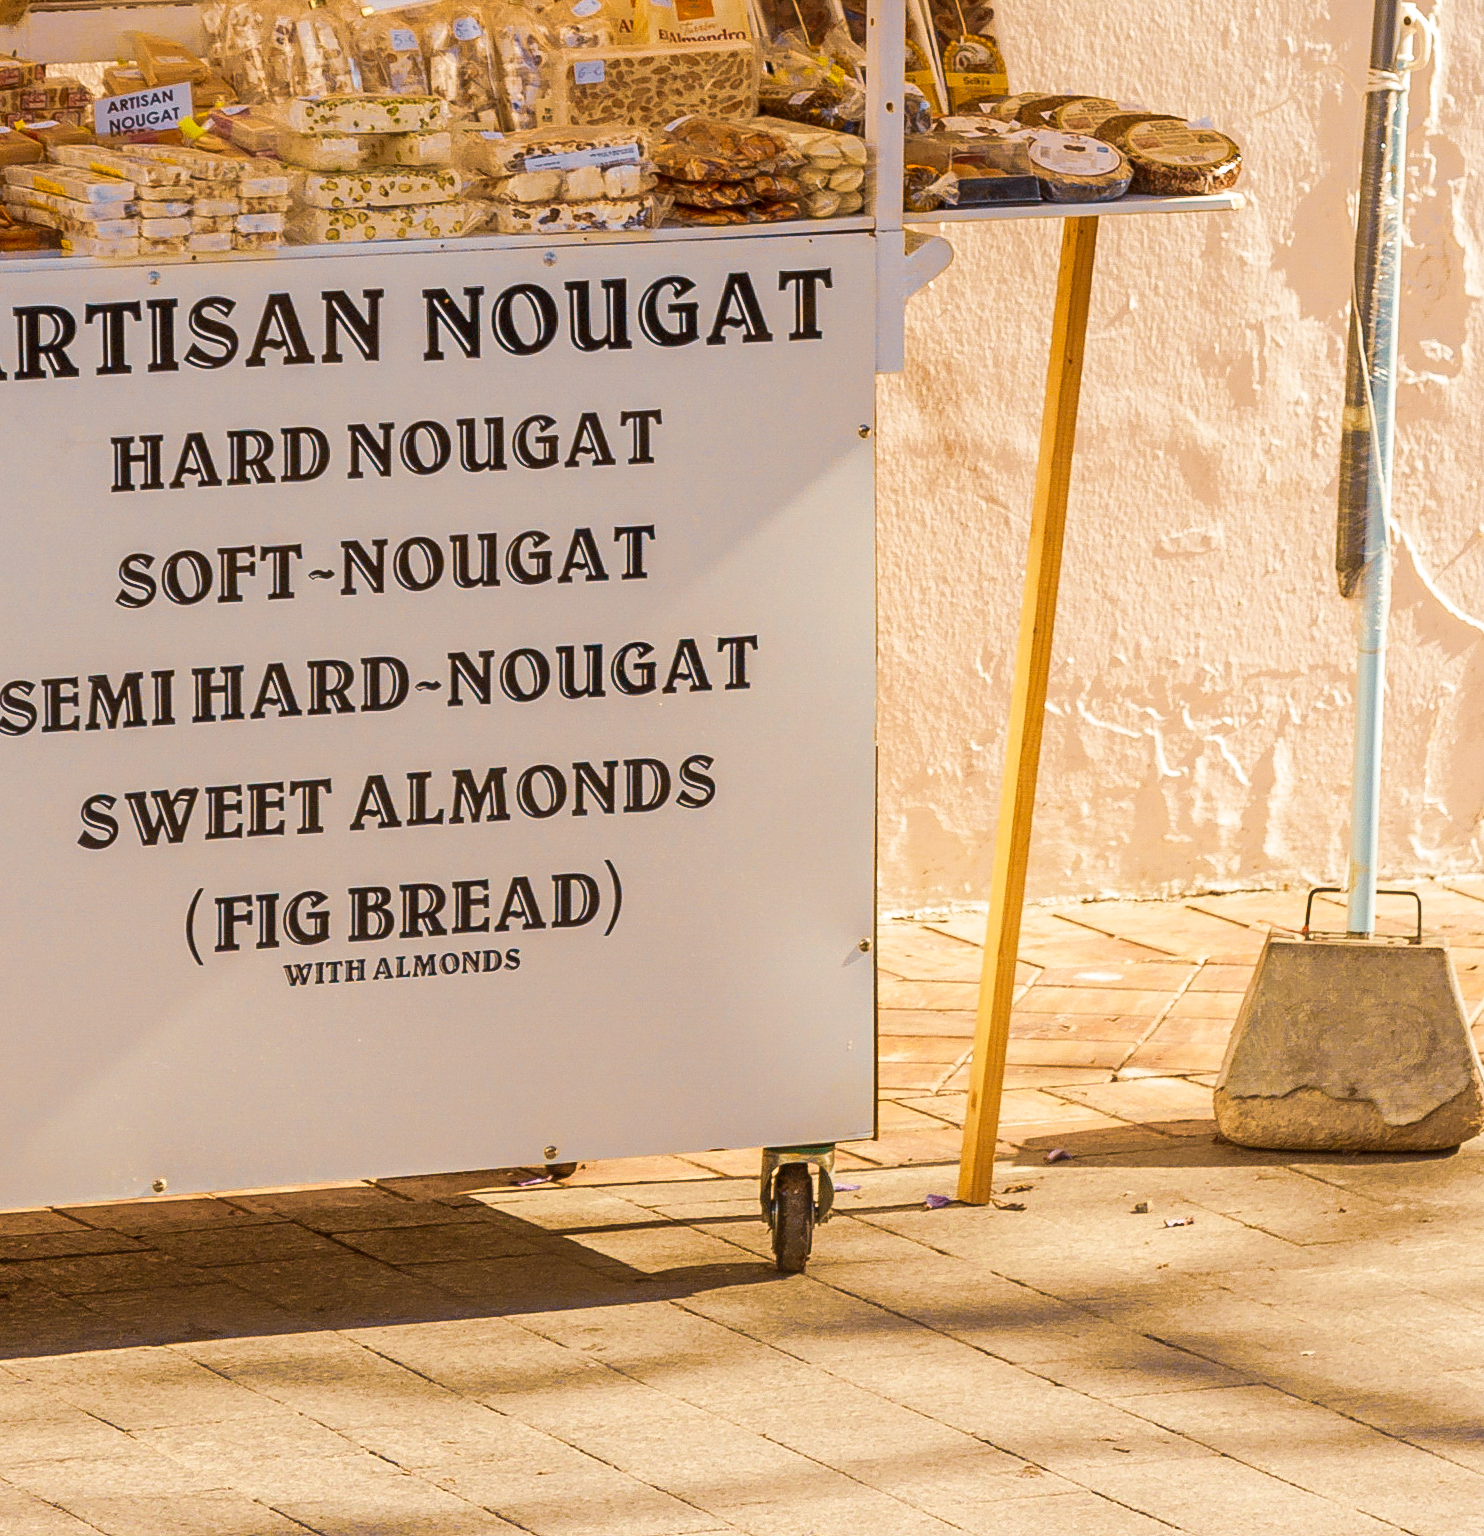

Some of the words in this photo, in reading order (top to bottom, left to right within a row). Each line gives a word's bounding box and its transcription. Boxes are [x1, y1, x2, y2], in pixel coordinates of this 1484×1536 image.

[107, 89, 174, 114] ARTISAN
[109, 107, 180, 131] NOUGAT
[424, 267, 832, 363] NOUGAT
[110, 426, 329, 494] HARD
[347, 408, 662, 480] NOUGAT
[77, 778, 331, 851] SWEET
[350, 753, 717, 833] ALMONDS
[185, 887, 330, 965] (FIG
[347, 859, 624, 944] BREAD)
[283, 957, 368, 987] WITH
[372, 947, 522, 982] ALMONDS
